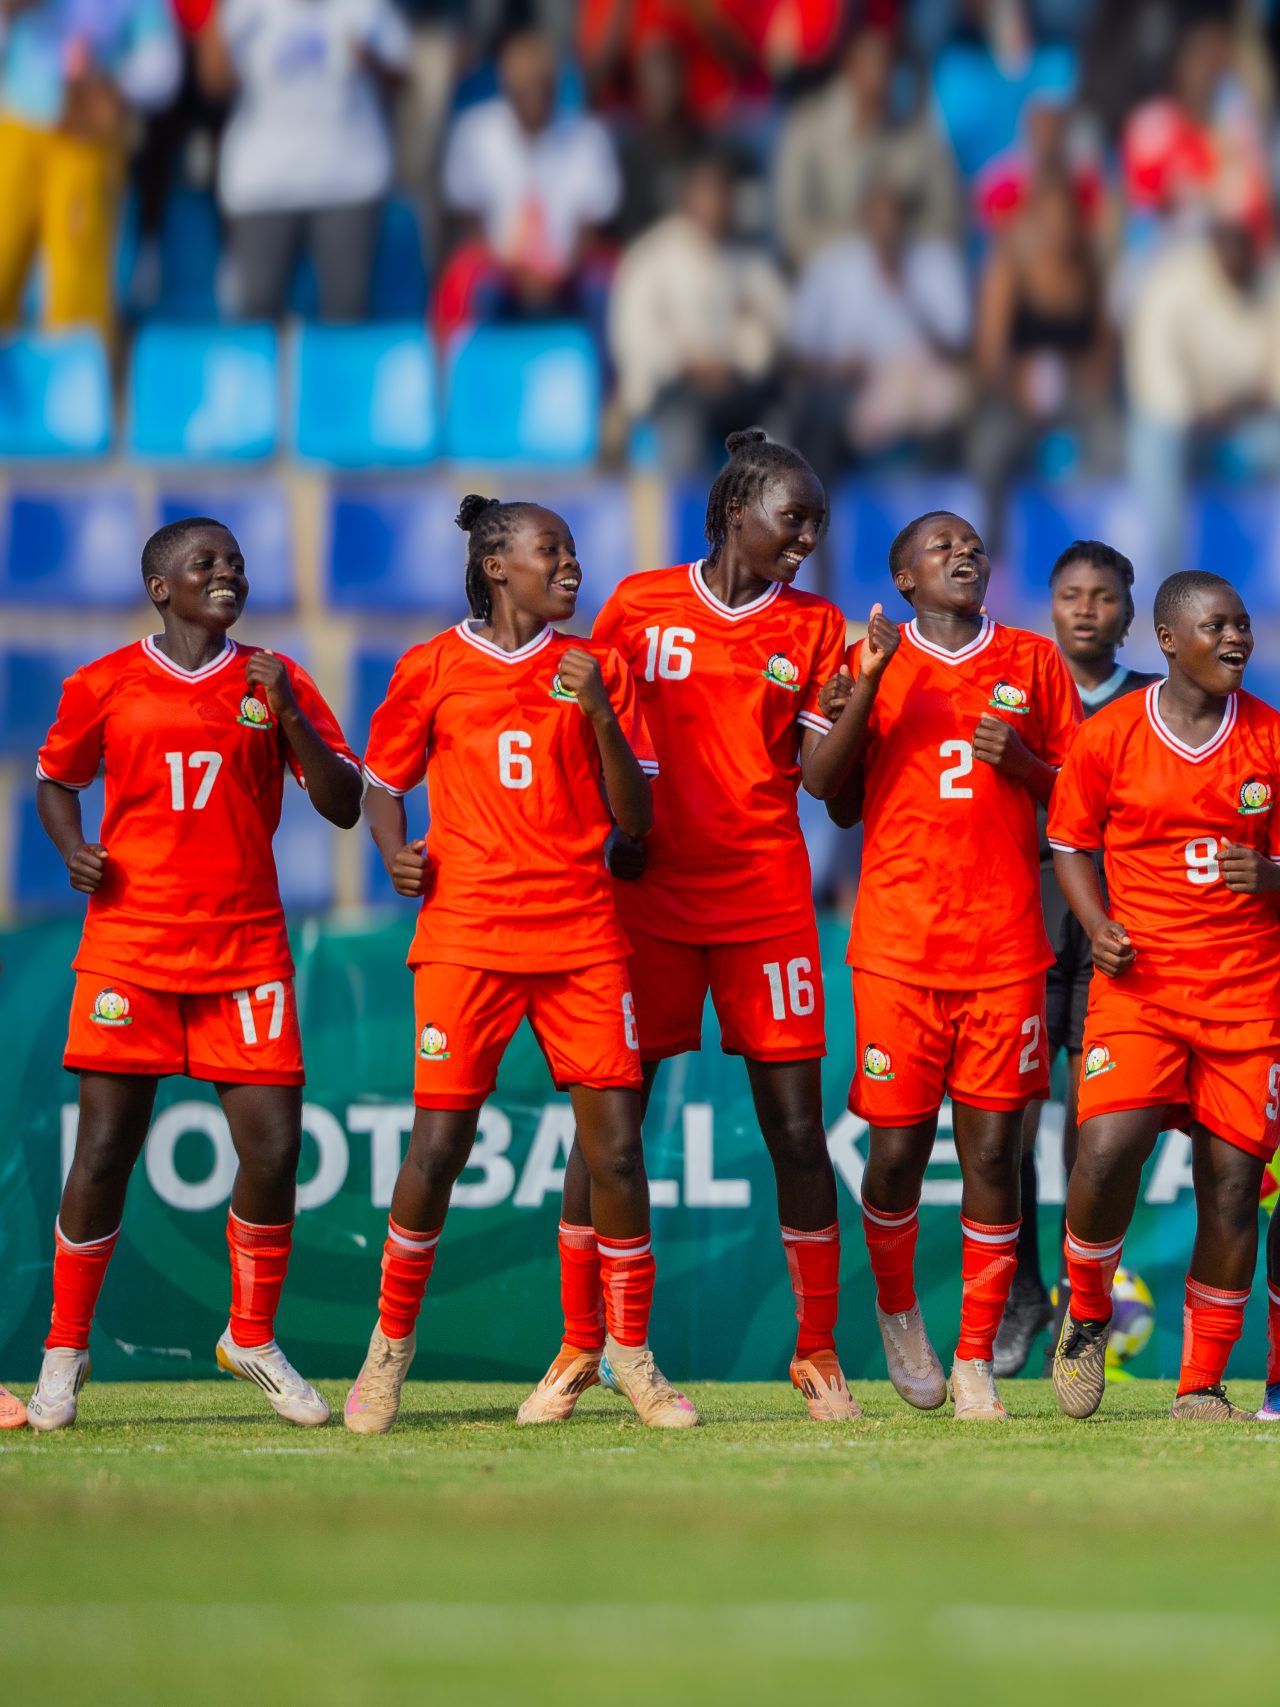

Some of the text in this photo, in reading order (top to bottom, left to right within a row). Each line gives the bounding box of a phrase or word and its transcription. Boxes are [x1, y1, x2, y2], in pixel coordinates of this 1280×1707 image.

[645, 626, 696, 682] 16
[166, 751, 223, 811] 17
[498, 731, 533, 789] 6
[940, 740, 973, 799] 2
[1185, 837, 1221, 884] 9
[233, 982, 285, 1045] 17
[764, 957, 815, 1020] 16
[1018, 1014, 1041, 1074] 2
